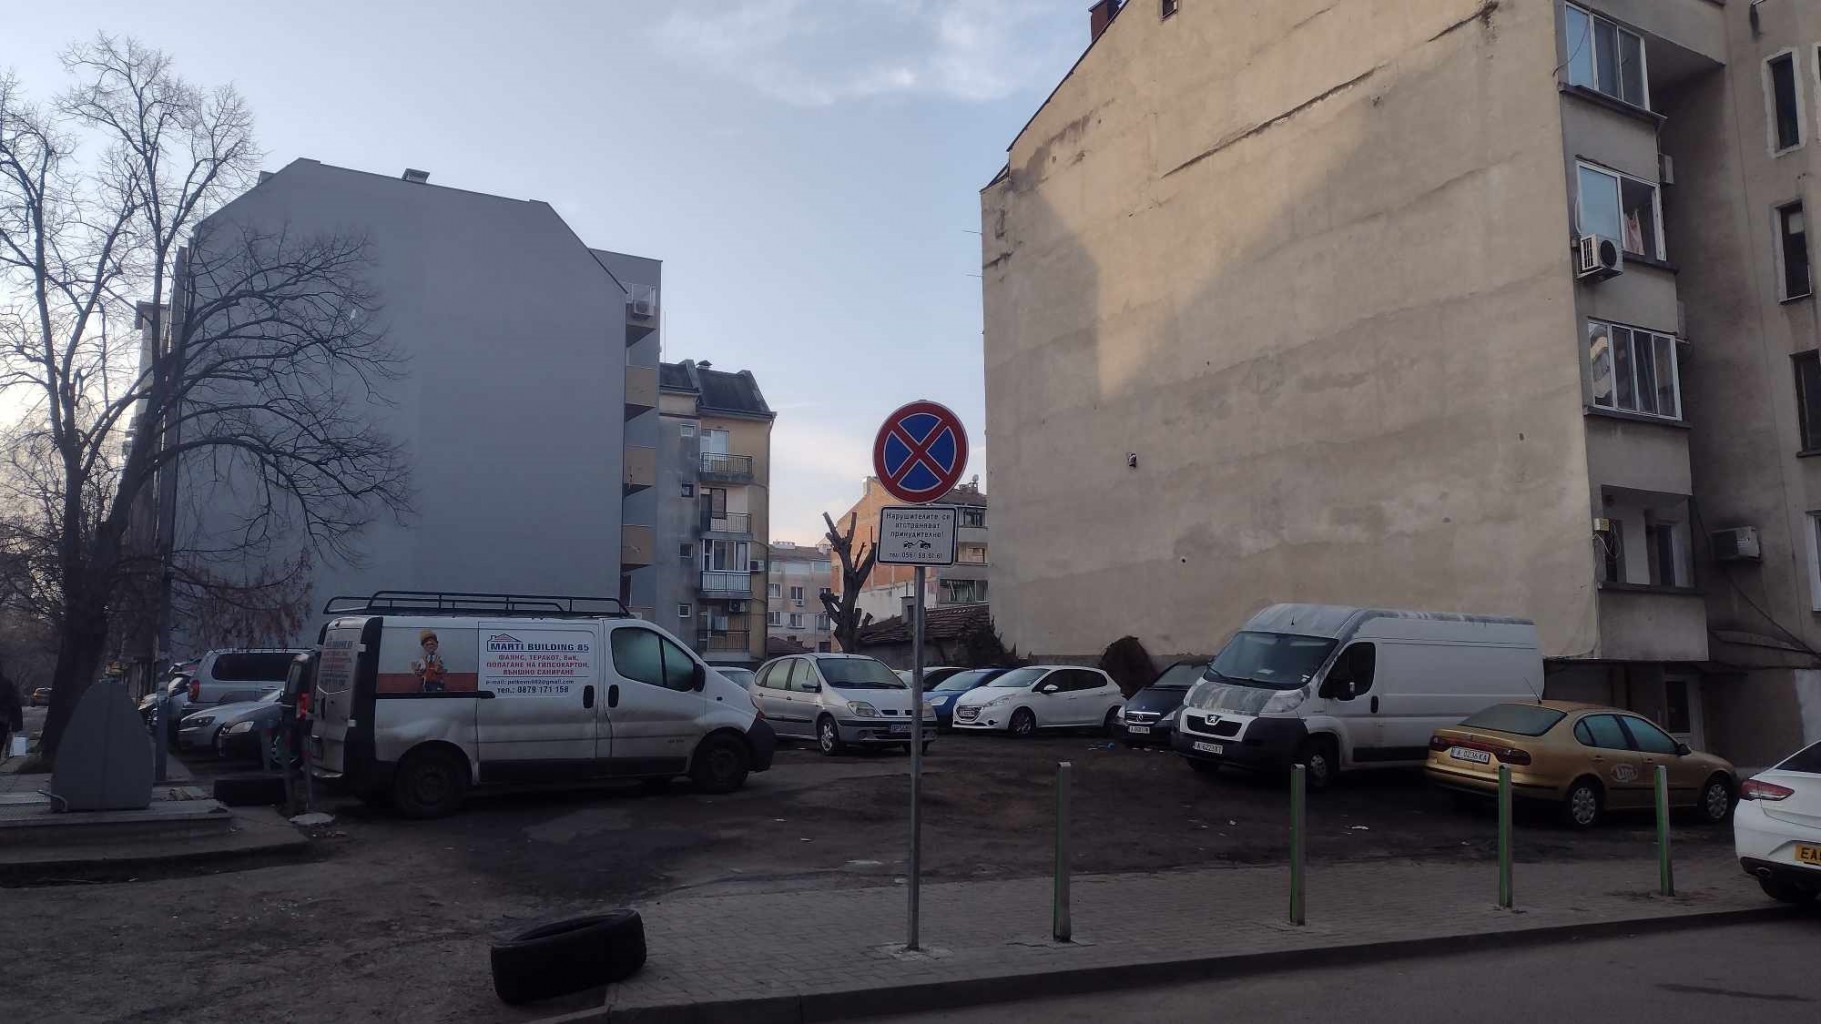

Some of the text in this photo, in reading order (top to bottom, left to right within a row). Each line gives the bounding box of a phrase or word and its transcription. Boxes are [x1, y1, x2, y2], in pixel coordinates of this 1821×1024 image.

[886, 511, 939, 520] Нарушителите
[490, 643, 524, 651] MARTI
[527, 643, 574, 651] BUILDING
